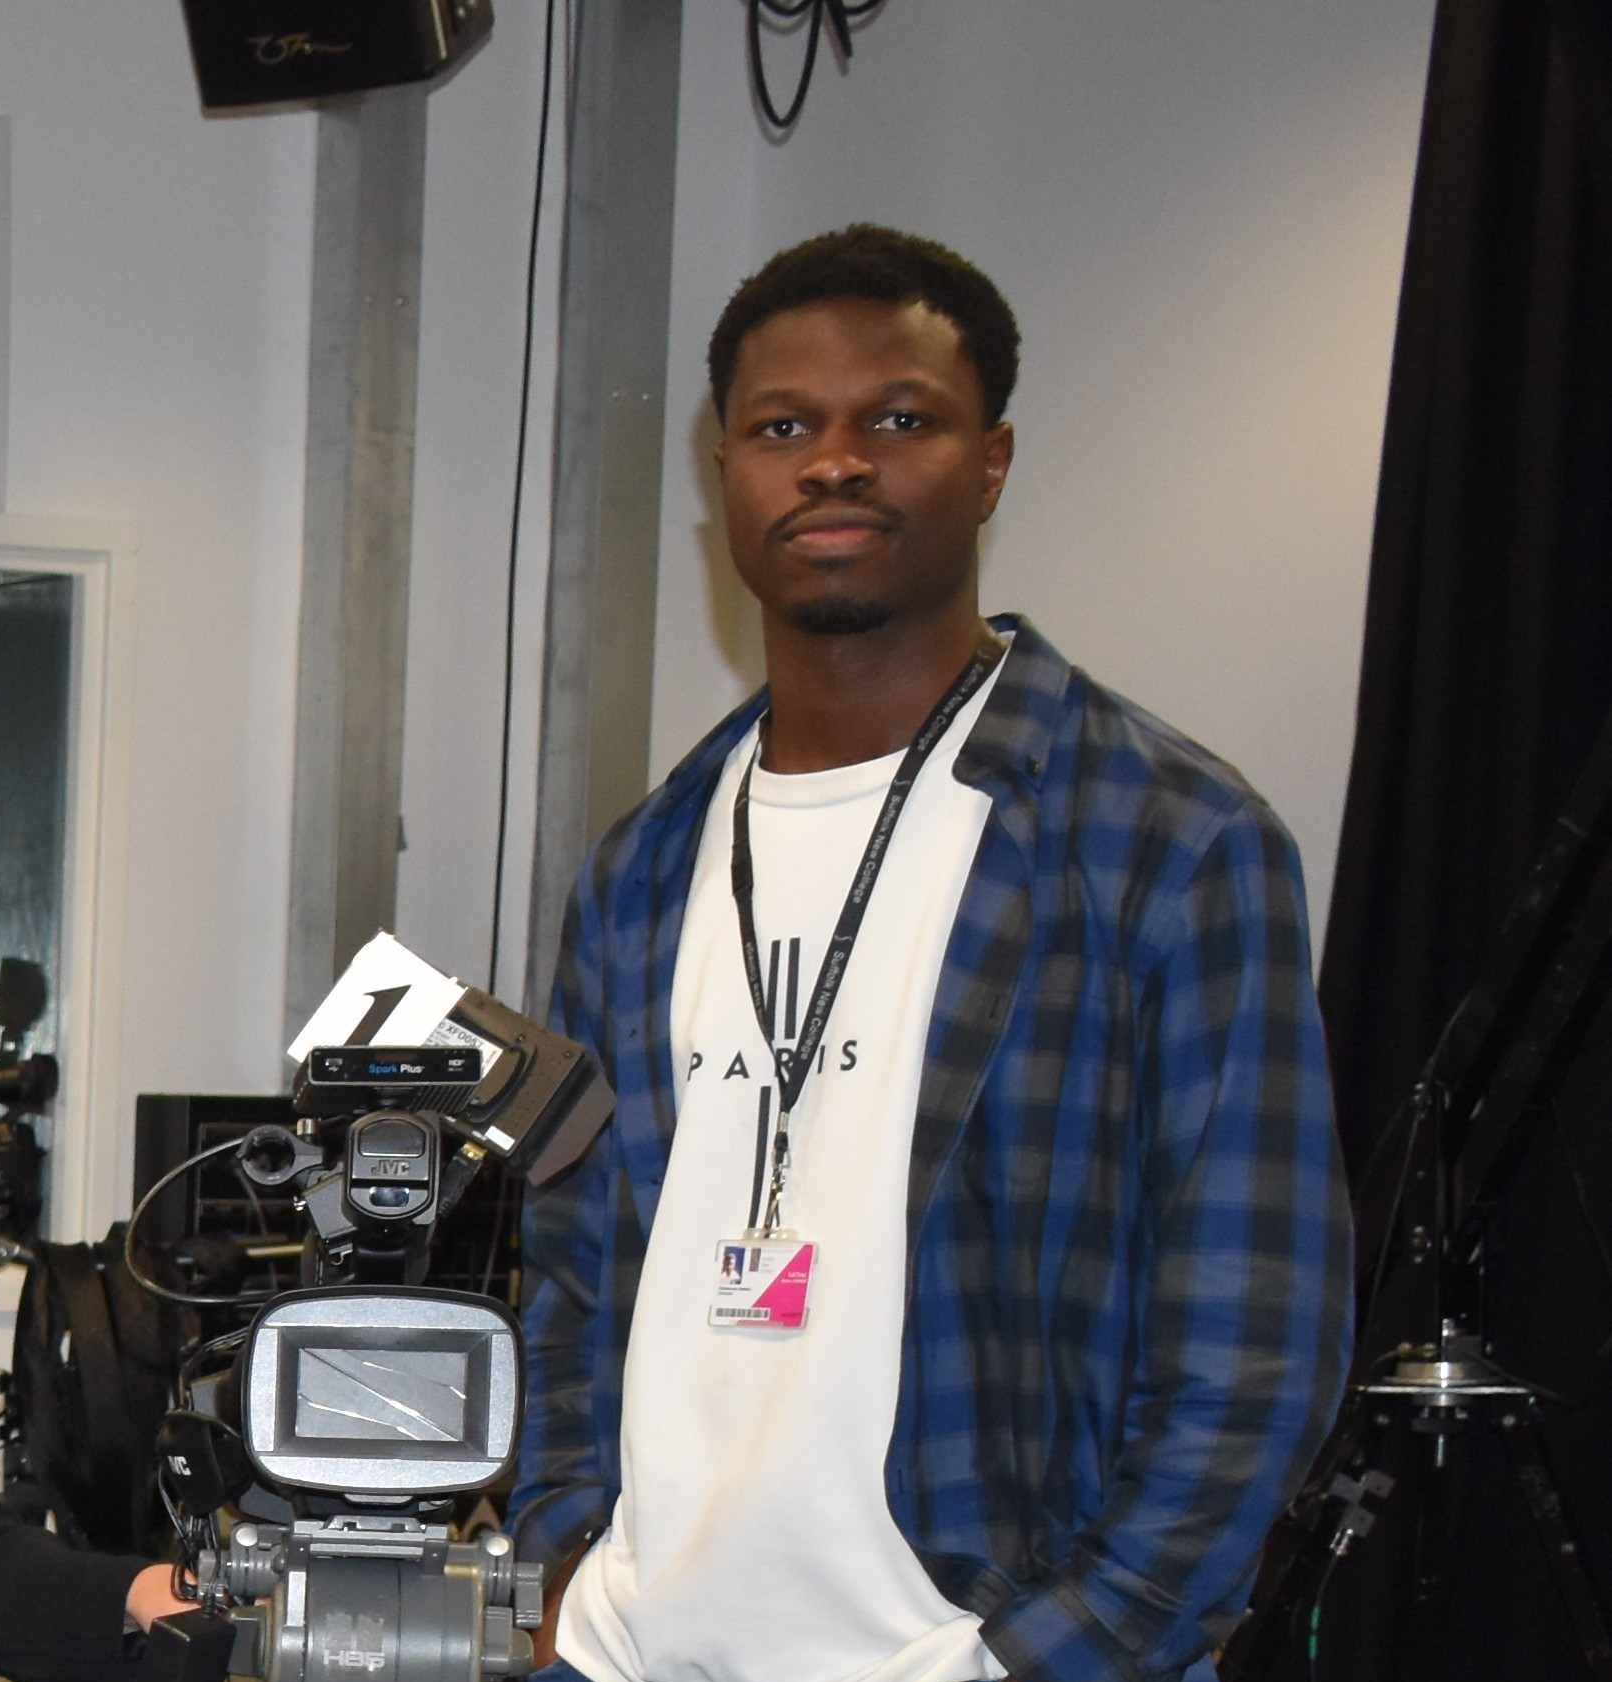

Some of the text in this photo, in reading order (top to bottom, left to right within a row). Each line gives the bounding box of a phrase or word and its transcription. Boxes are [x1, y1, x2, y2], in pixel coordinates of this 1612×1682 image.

[344, 983, 414, 1047] 1
[368, 1063, 424, 1075] Spark Plus
[370, 1159, 411, 1177] JVC
[322, 1648, 386, 1670] H85
